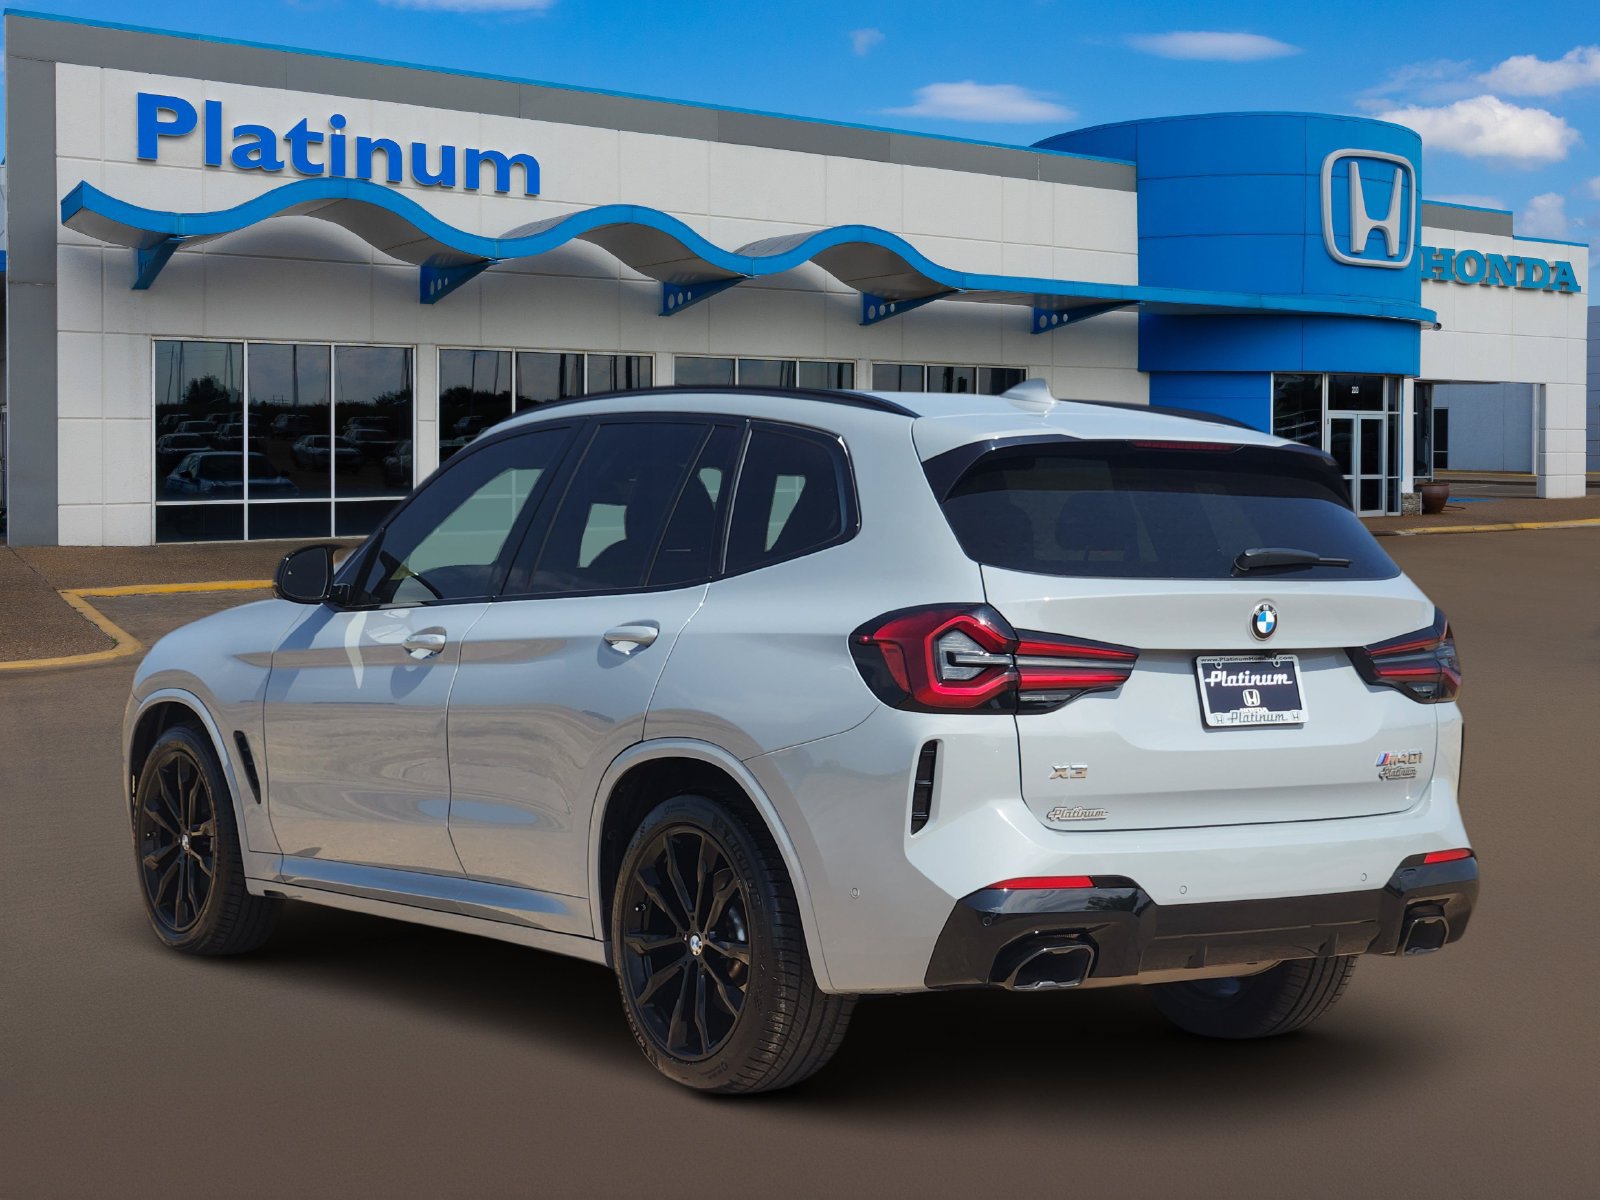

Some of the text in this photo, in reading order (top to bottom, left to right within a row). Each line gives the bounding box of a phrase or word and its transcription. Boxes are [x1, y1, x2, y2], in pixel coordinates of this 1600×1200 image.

[137, 92, 540, 196] Platinum
[1421, 246, 1581, 292] HONDA
[1205, 670, 1293, 687] Platinum
[1228, 711, 1288, 724] Platinum
[1048, 764, 1088, 780] X3
[1379, 766, 1417, 781] Platinum
[1047, 806, 1108, 822] Platinum
